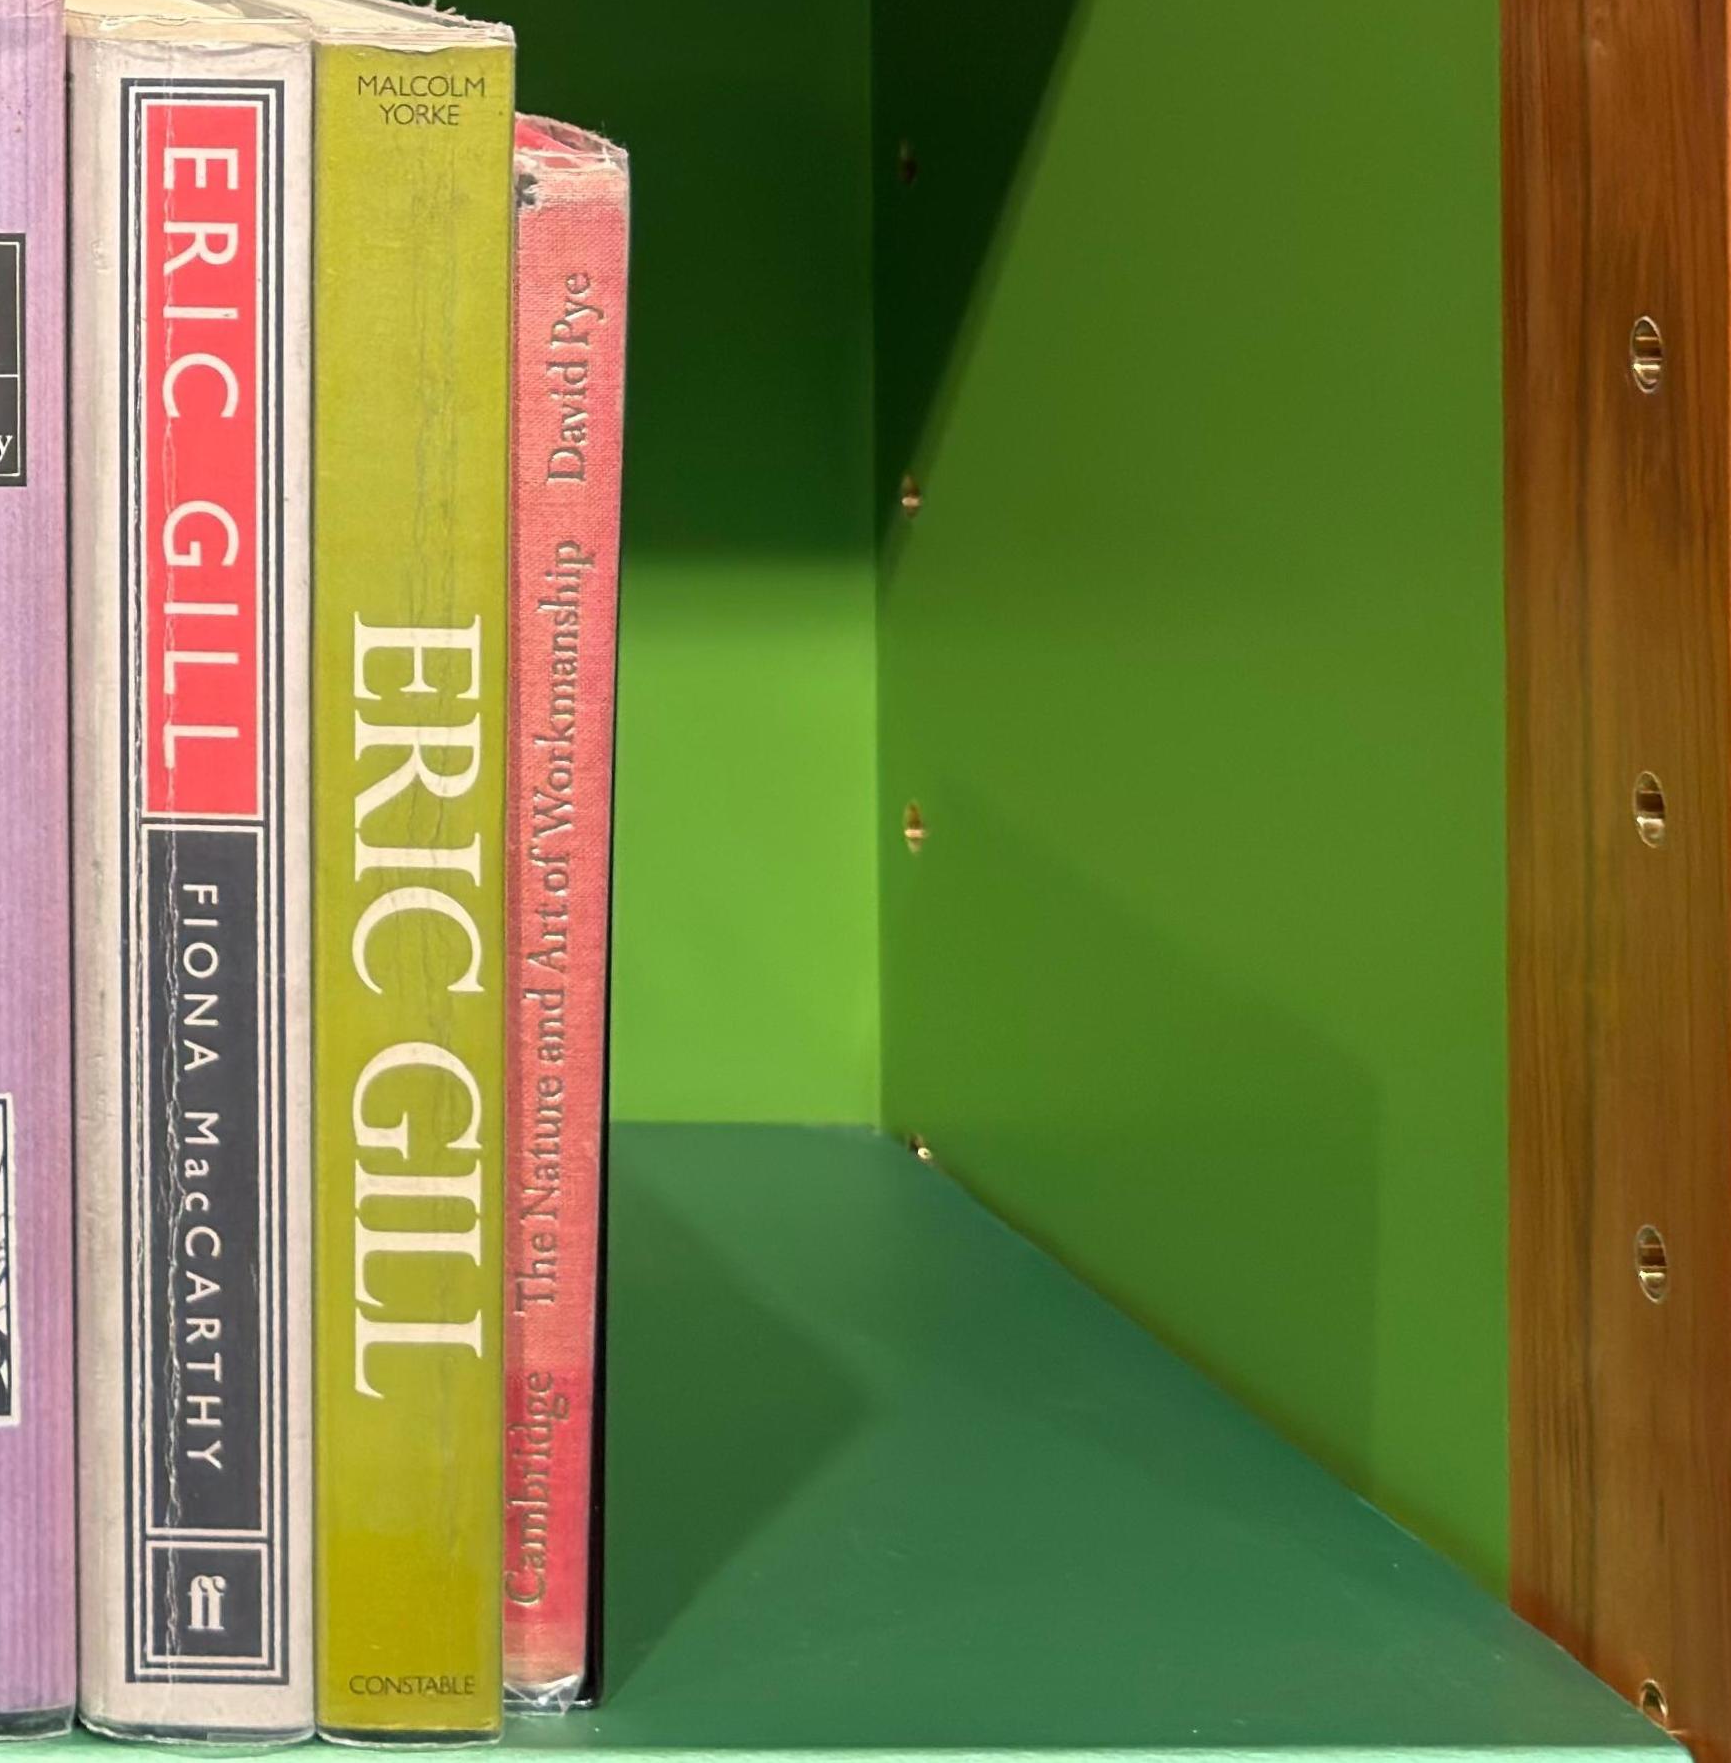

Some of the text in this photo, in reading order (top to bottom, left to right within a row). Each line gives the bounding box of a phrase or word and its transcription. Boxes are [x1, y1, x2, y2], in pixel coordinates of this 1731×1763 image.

[357, 75, 486, 97] MALCOLM
[379, 104, 460, 126] YORKE
[161, 145, 240, 771] ERIC GILL
[182, 880, 222, 1474] FIONA MacCARTHY
[353, 611, 483, 1401] ERIC GILL
[505, 271, 605, 1606] Cambridge The Nature and Art of Workmanship David Pye
[349, 1674, 476, 1697] CONSTABLE
